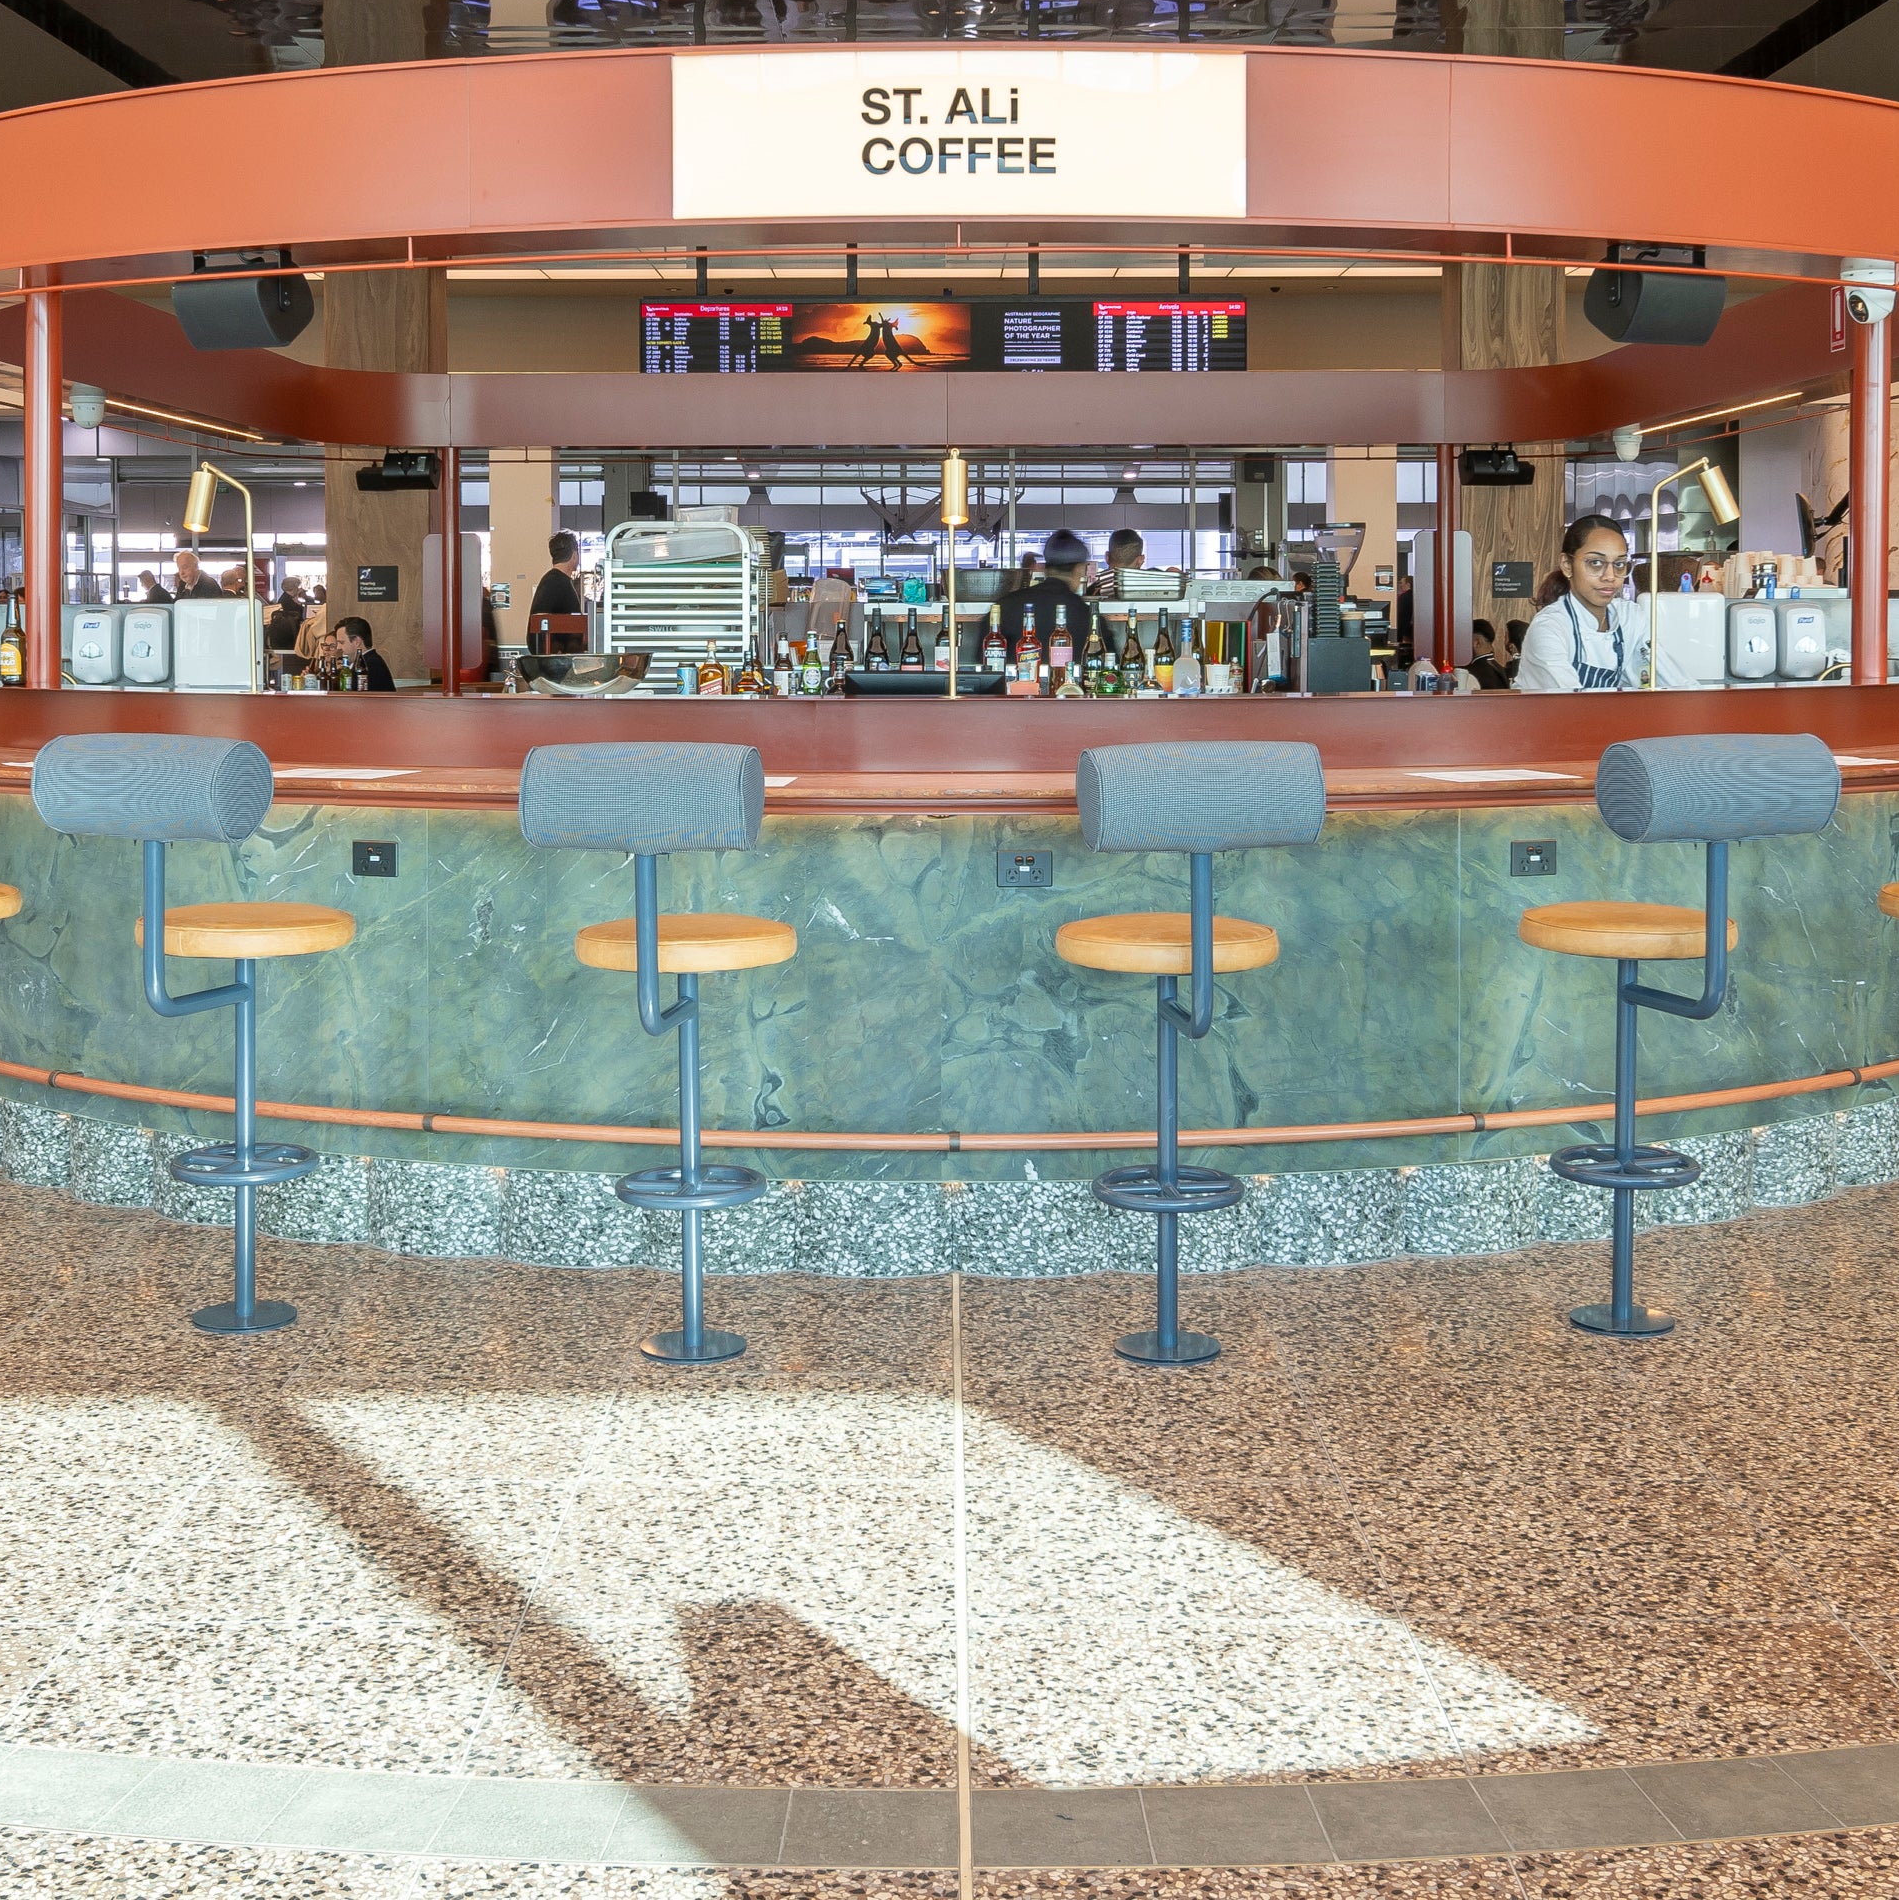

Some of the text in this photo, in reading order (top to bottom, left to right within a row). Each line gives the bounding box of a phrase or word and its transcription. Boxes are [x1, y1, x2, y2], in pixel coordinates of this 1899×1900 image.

[861, 87, 1018, 125] ST. ALi
[861, 136, 1057, 175] COFFEE
